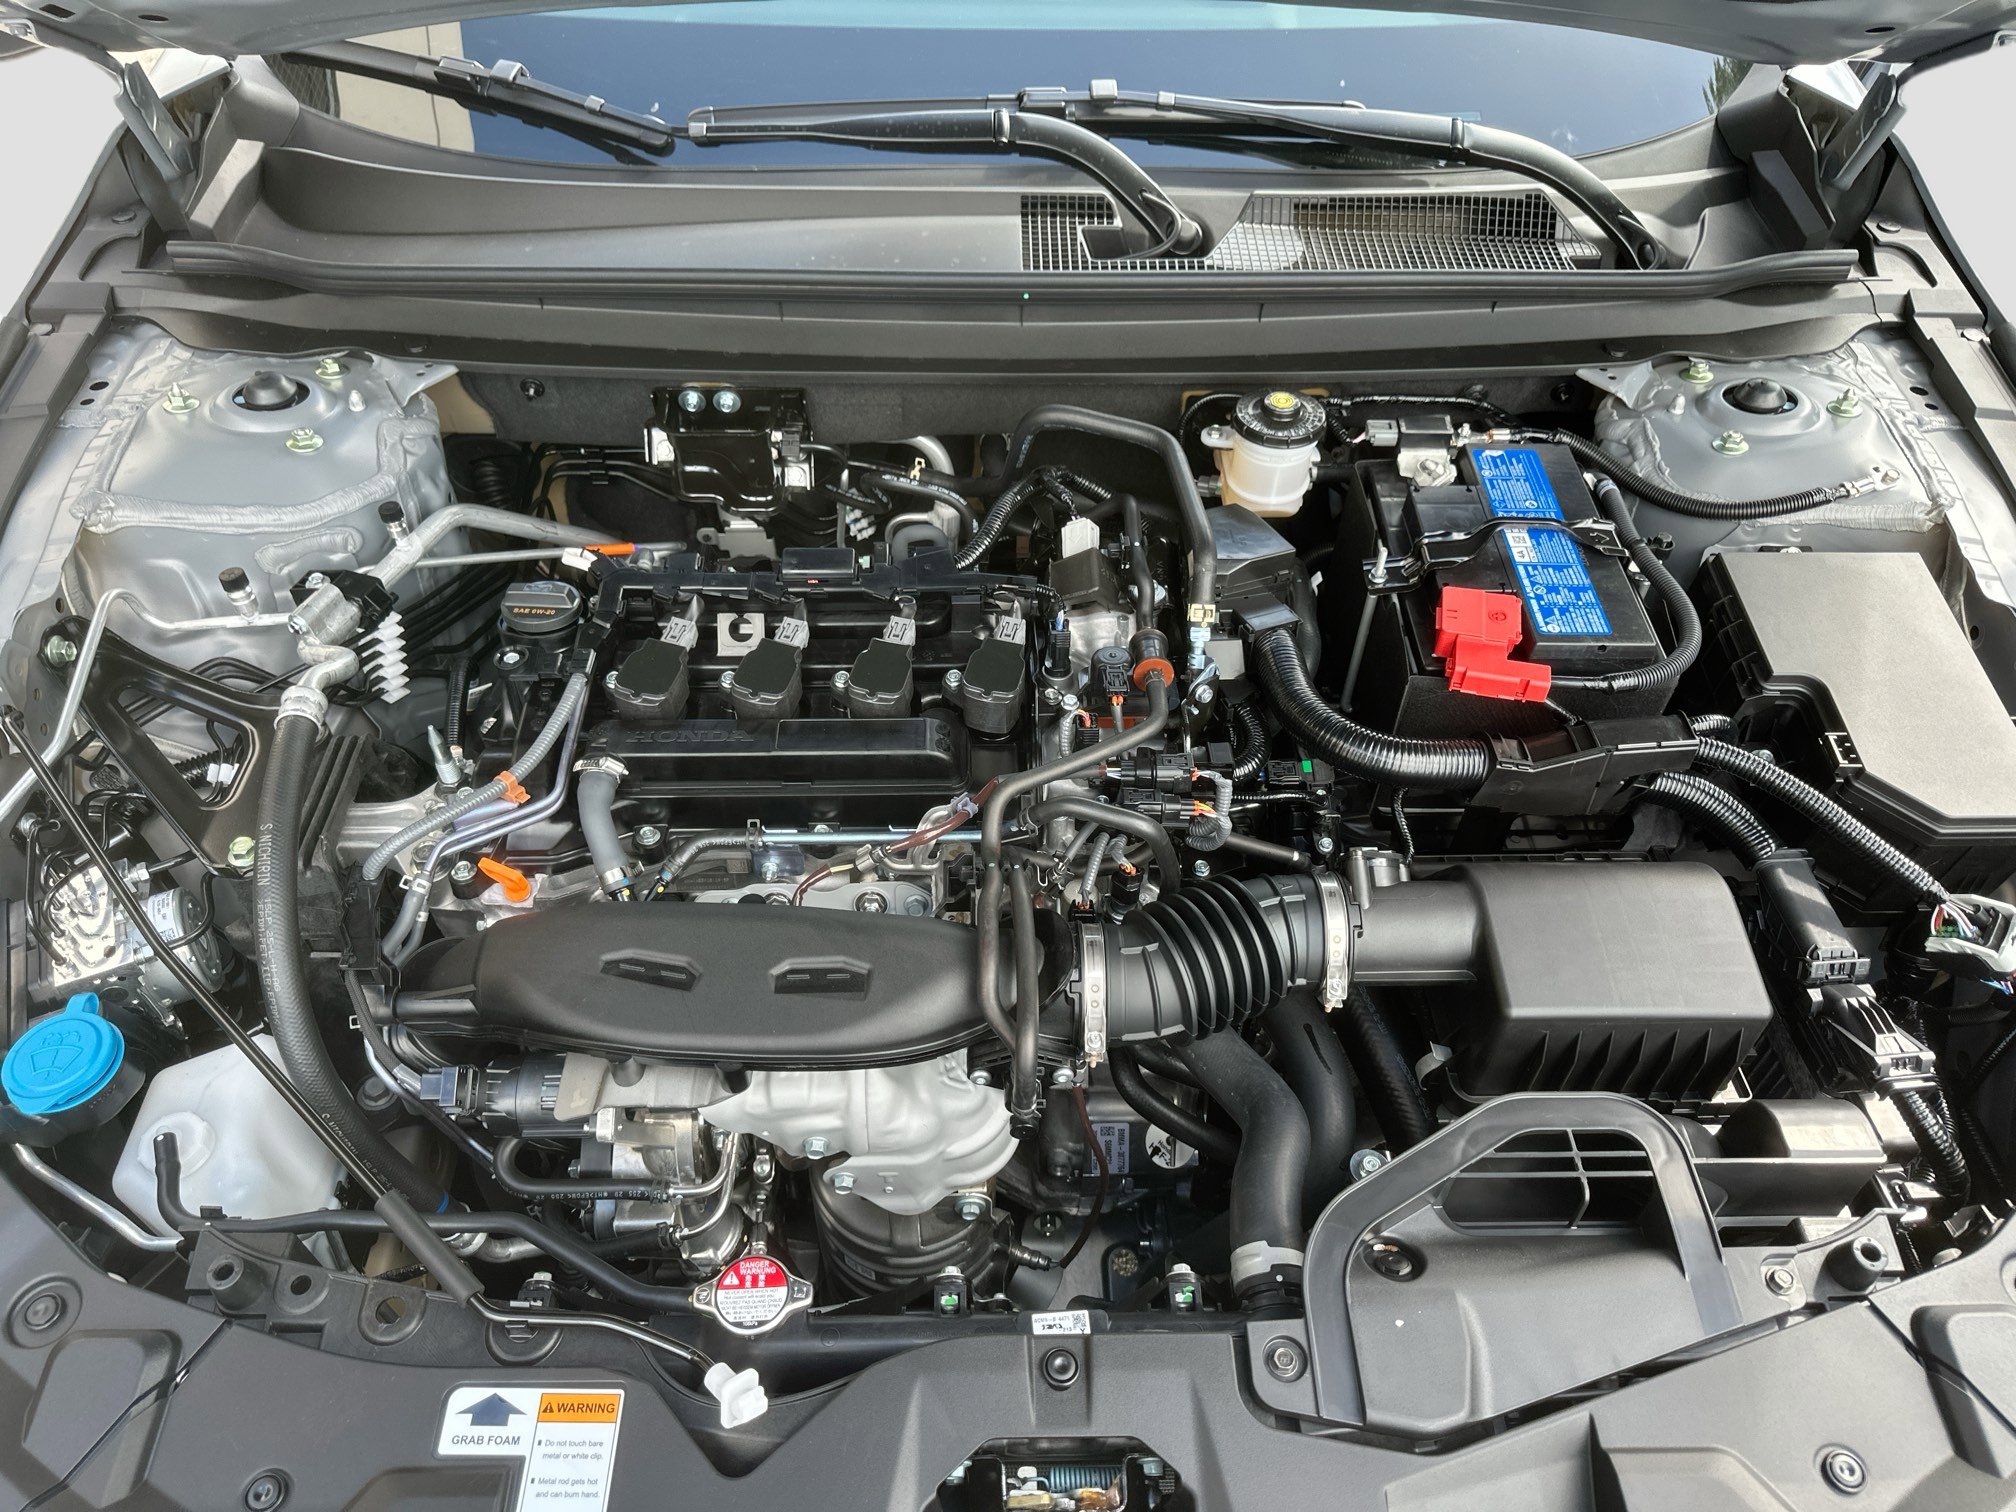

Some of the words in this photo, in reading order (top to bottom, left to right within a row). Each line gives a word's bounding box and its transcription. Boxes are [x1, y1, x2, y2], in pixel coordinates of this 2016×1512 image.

[625, 729, 755, 743] HONDA
[740, 1267, 777, 1275] WARNUNG
[557, 1402, 615, 1414] WARNING
[451, 1435, 484, 1446] GRAB
[487, 1435, 521, 1446] FOAM
[555, 1439, 567, 1447] not
[542, 1452, 561, 1460] metal
[571, 1452, 588, 1460] white
[589, 1452, 603, 1461] clip.
[570, 1478, 586, 1487] gets
[535, 1490, 547, 1498] and
[564, 1490, 580, 1498] burn
[581, 1490, 600, 1498] hand.
